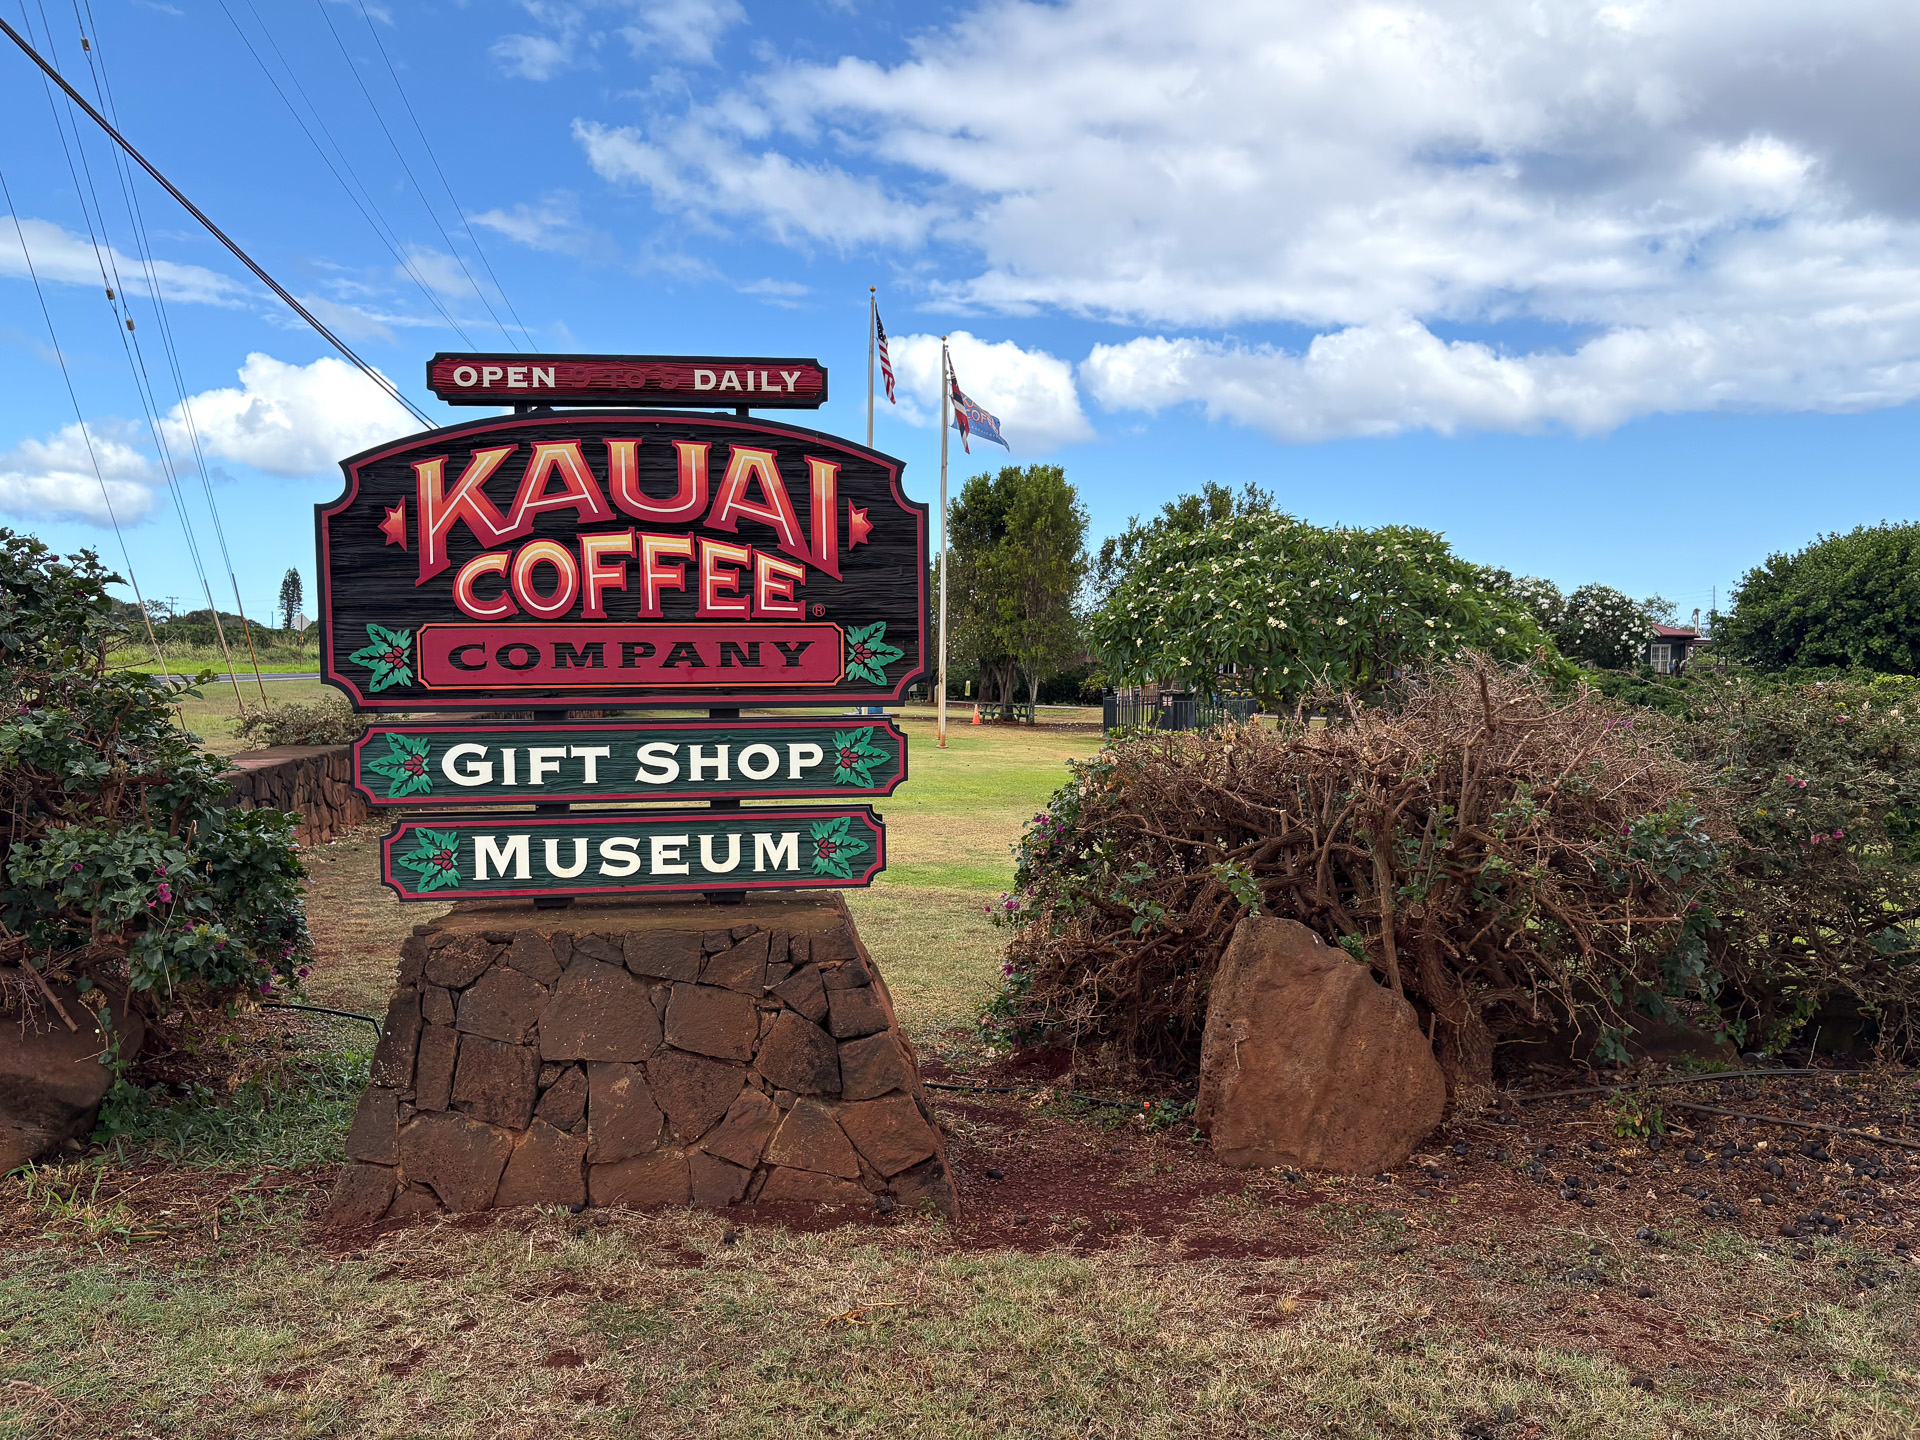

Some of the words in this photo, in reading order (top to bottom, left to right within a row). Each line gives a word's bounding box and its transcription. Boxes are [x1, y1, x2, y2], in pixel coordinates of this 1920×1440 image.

[453, 366, 556, 388] OPEN
[570, 366, 592, 389] 9
[605, 370, 646, 389] TO
[658, 368, 679, 390] 5
[693, 369, 802, 393] DAILY
[410, 438, 844, 587] KAUAI
[452, 526, 806, 621] COFFEE
[448, 641, 817, 672] COMPANY
[441, 743, 610, 787] GIFT
[635, 741, 824, 784] SHOP
[472, 831, 801, 881] MUSEUM
